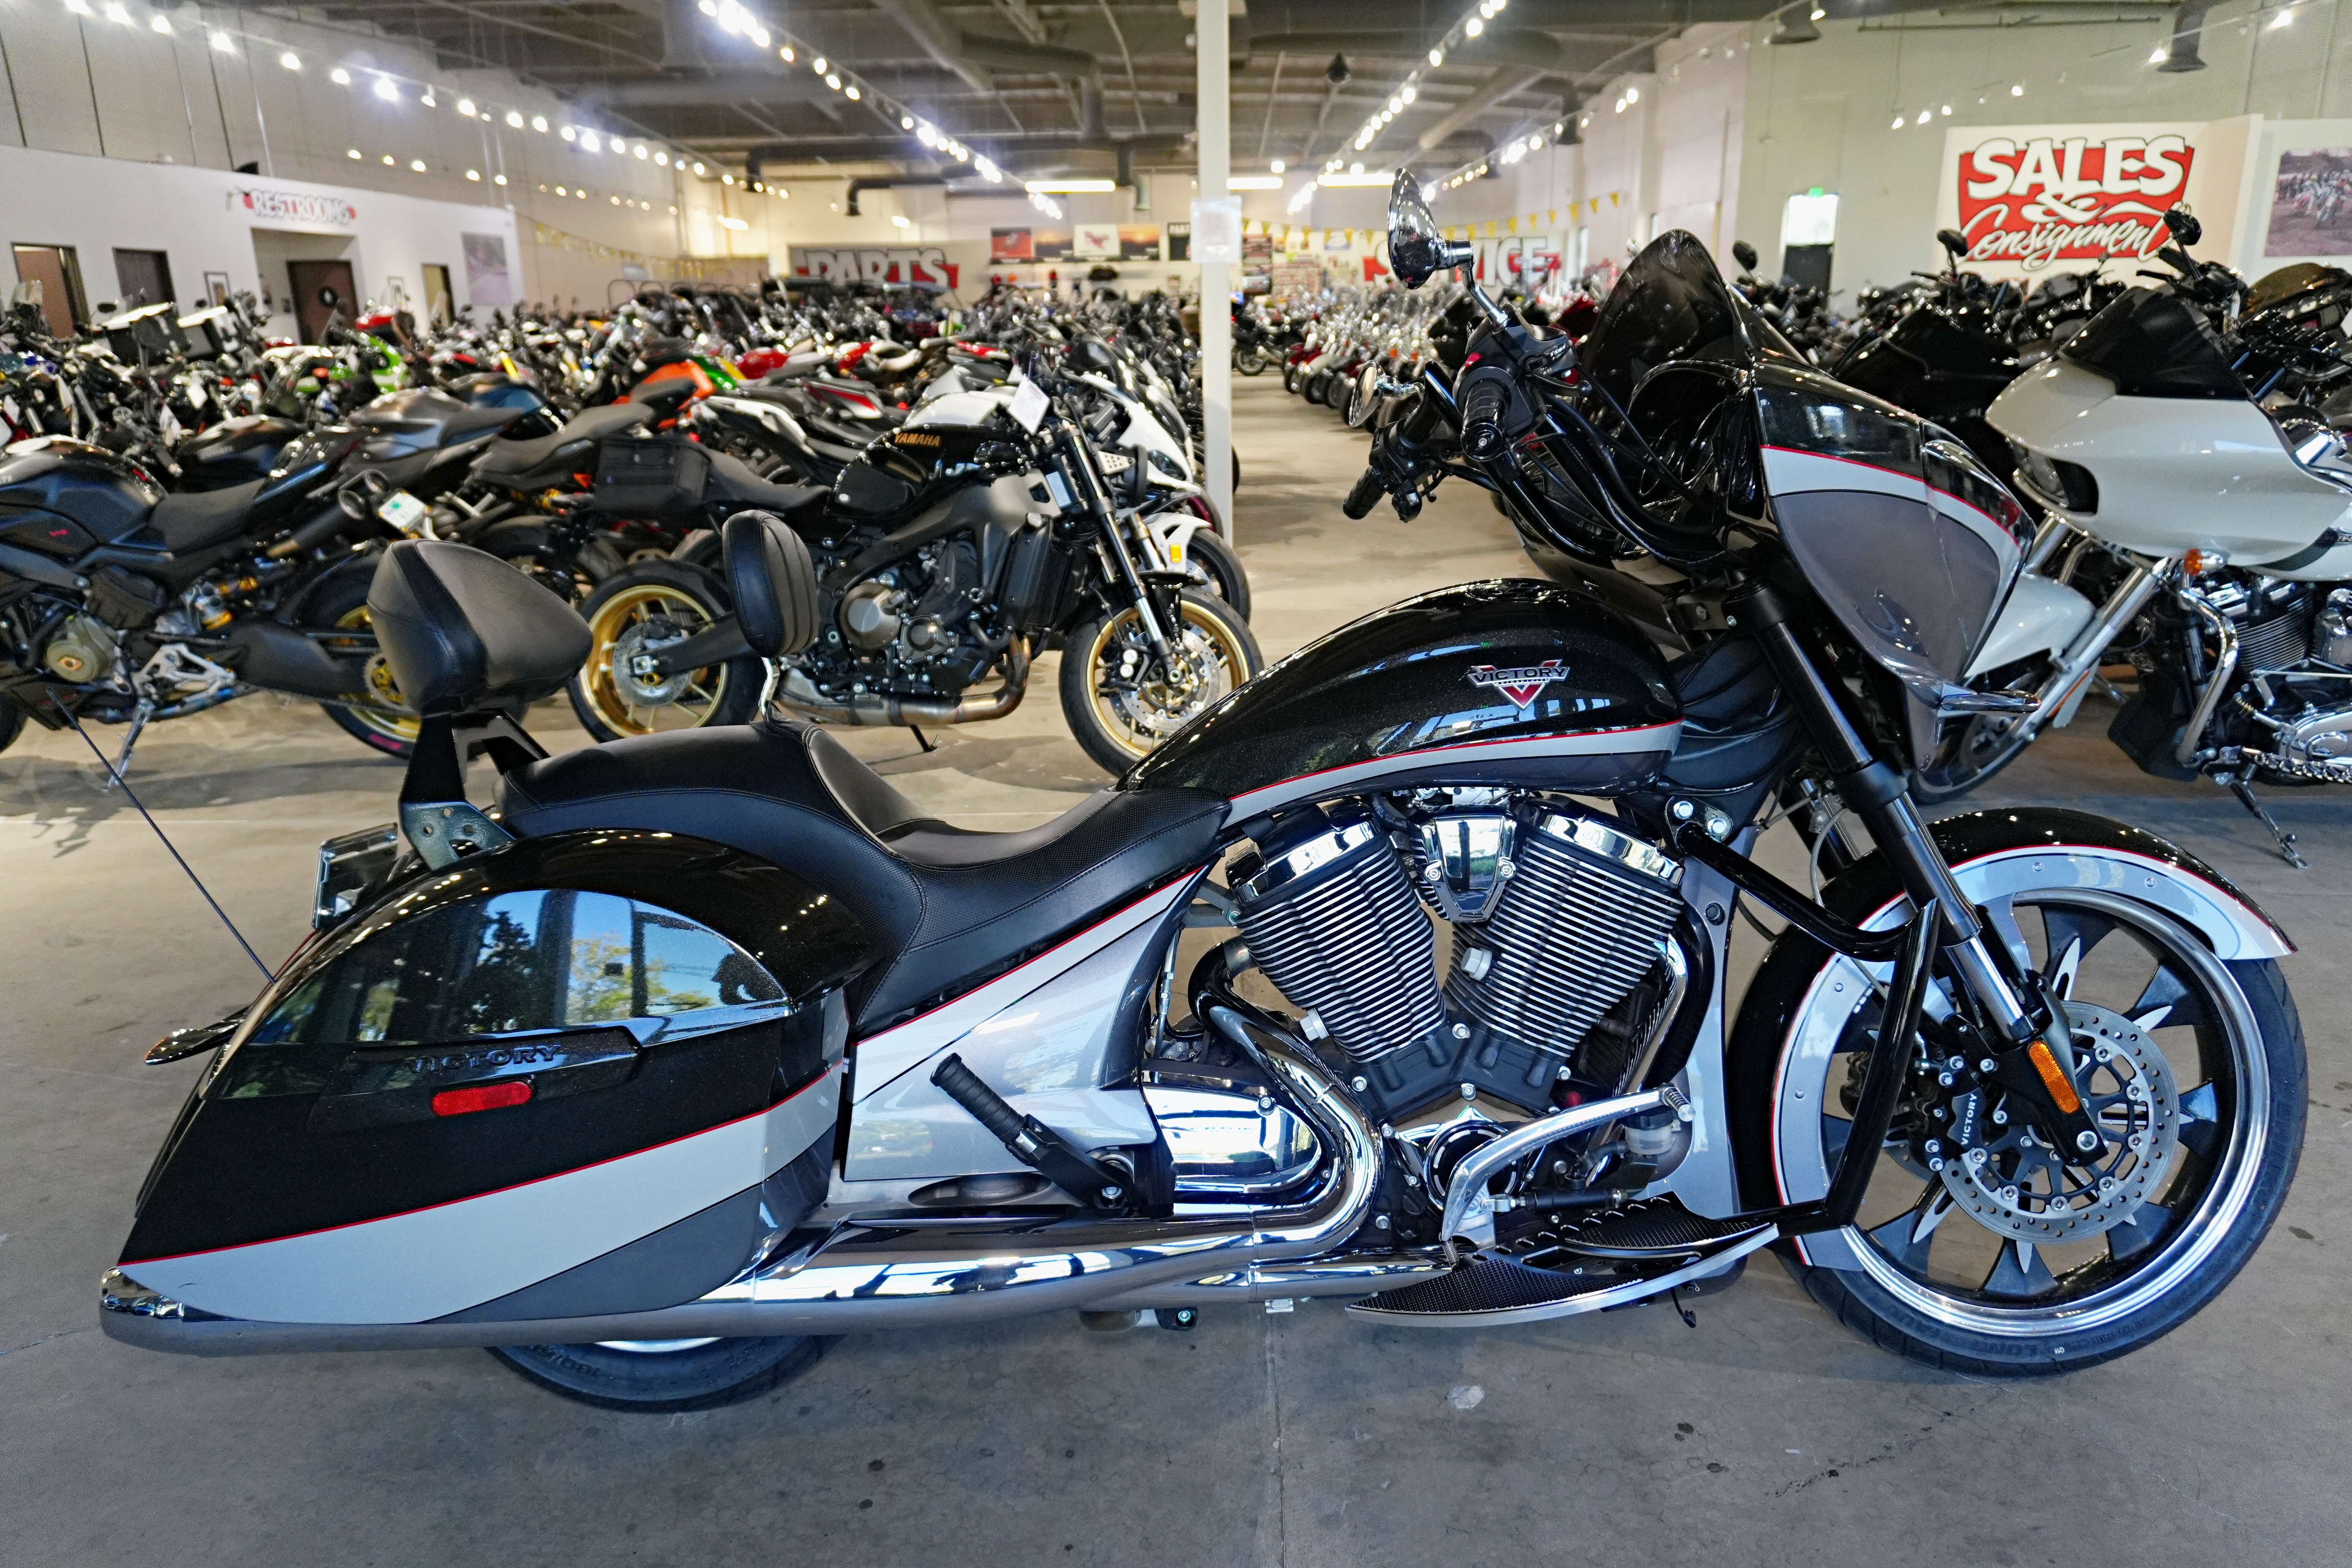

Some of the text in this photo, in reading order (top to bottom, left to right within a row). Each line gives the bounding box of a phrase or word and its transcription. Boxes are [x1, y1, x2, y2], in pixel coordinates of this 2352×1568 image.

[1967, 134, 2186, 199] SALES
[250, 188, 351, 226] RESTROOMS
[1958, 202, 2178, 271] Consignment
[804, 248, 949, 287] PARTS
[894, 432, 941, 447] YAMAHA
[1474, 667, 1566, 682] VICTORY
[406, 1044, 561, 1073] VICTORY
[1961, 1093, 1977, 1146] VICTORY
